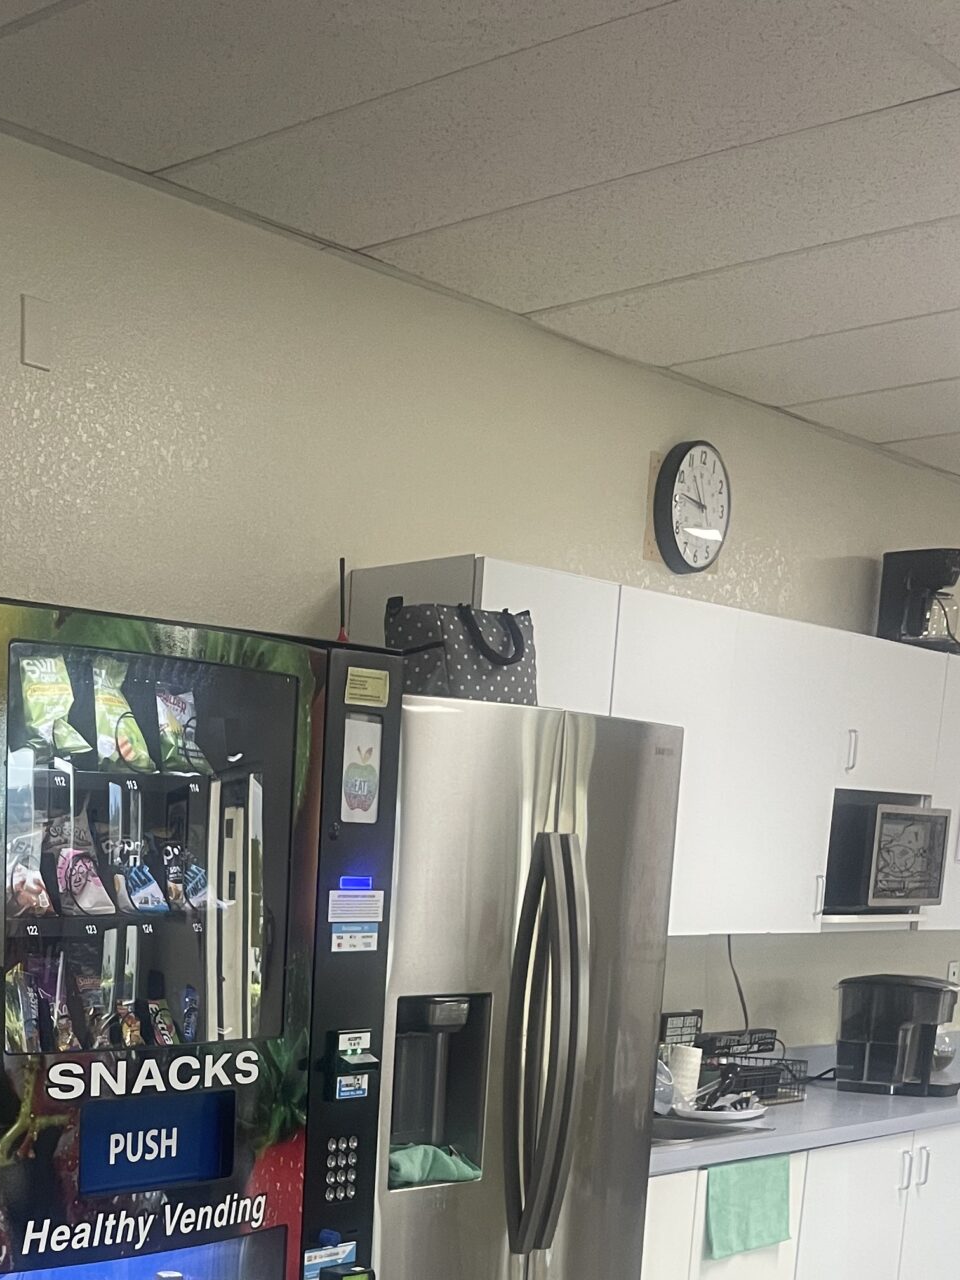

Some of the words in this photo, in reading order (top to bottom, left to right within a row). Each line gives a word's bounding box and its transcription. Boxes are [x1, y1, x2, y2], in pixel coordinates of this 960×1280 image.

[700, 450, 707, 465] 12
[719, 480, 724, 494] 2
[719, 505, 724, 519] 3
[674, 521, 680, 534] 8
[693, 547, 699, 563] 6
[705, 546, 710, 560] 5
[54, 776, 66, 787] 112
[126, 780, 138, 791] 113
[26, 926, 38, 936] 122
[85, 925, 97, 935] 123
[142, 923, 153, 934] 124
[47, 1050, 259, 1100] SNACKS
[109, 1127, 178, 1165] PUSH
[21, 1210, 155, 1255] Healthy
[163, 1193, 267, 1238] Vending
